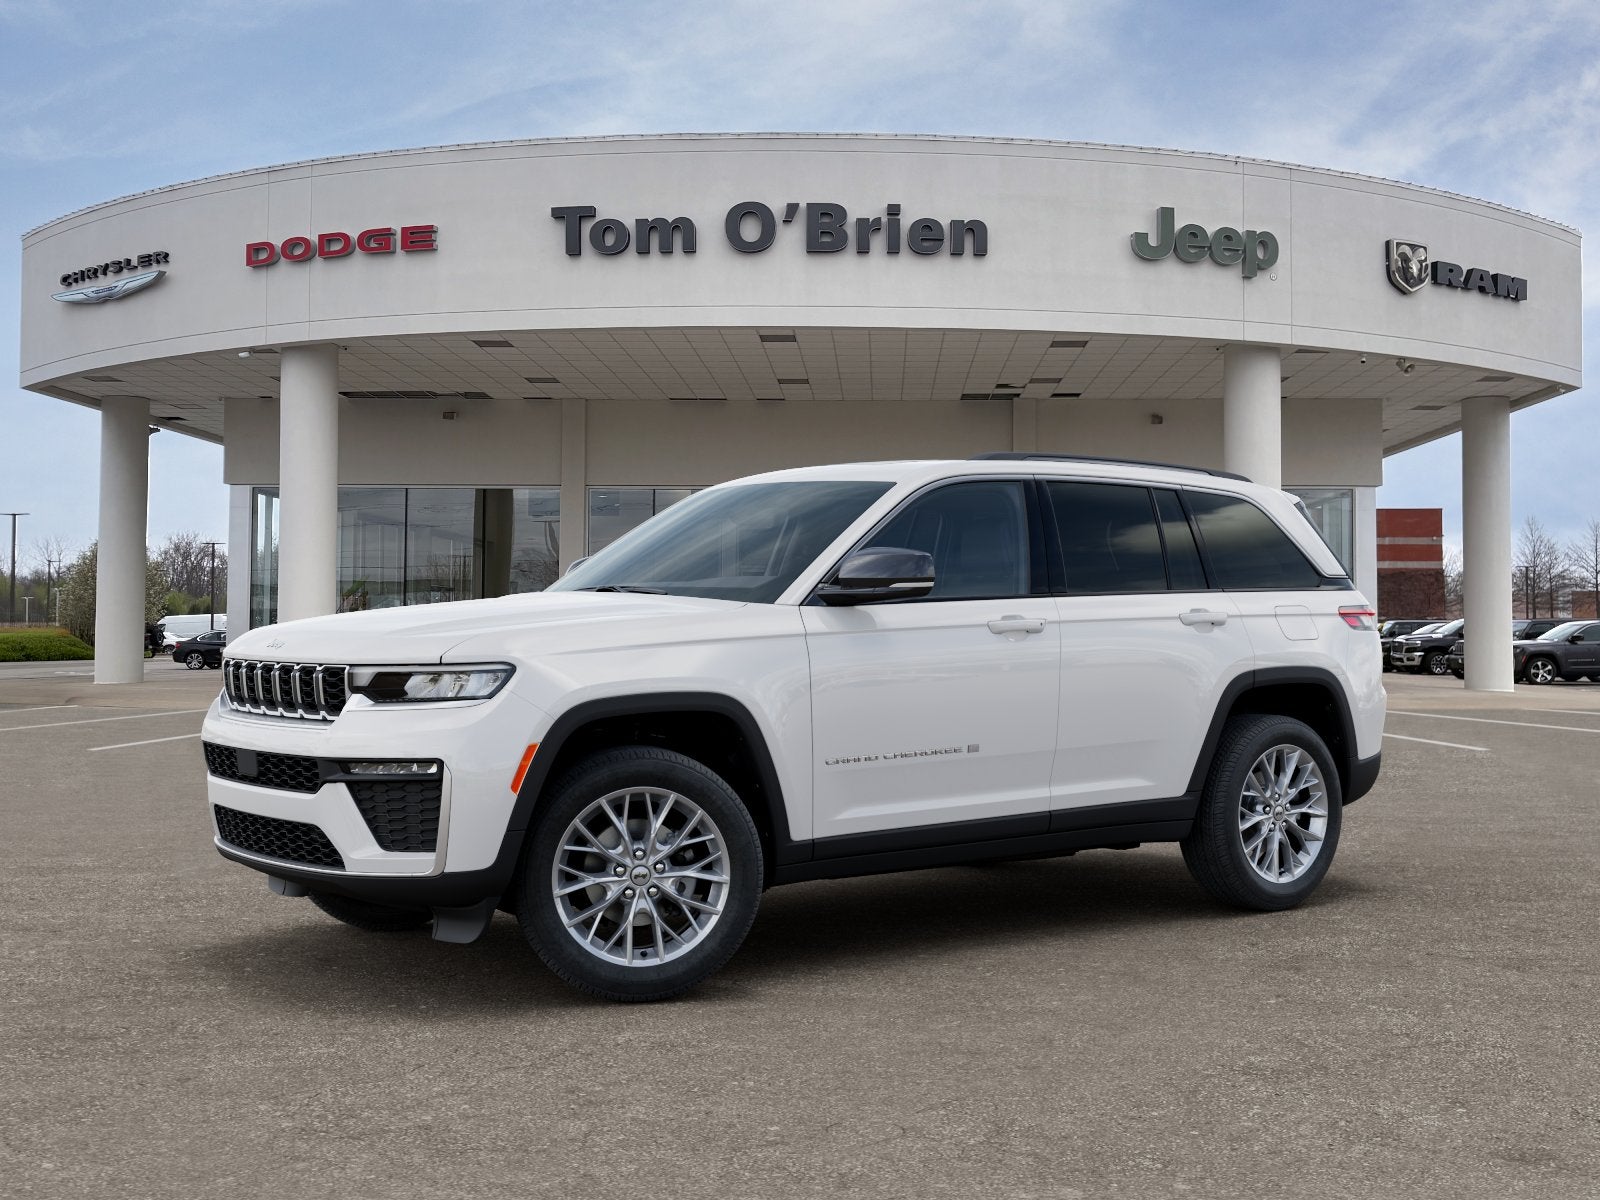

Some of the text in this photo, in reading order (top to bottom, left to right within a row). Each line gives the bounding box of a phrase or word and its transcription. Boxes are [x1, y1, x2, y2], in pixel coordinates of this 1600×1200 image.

[245, 224, 438, 269] DODGE
[551, 201, 989, 256] Tom O'Brien
[1130, 206, 1280, 279] Jeep
[60, 250, 170, 287] CHRYSLER
[1431, 261, 1528, 302] RAM
[883, 747, 963, 760] CHEROKEE
